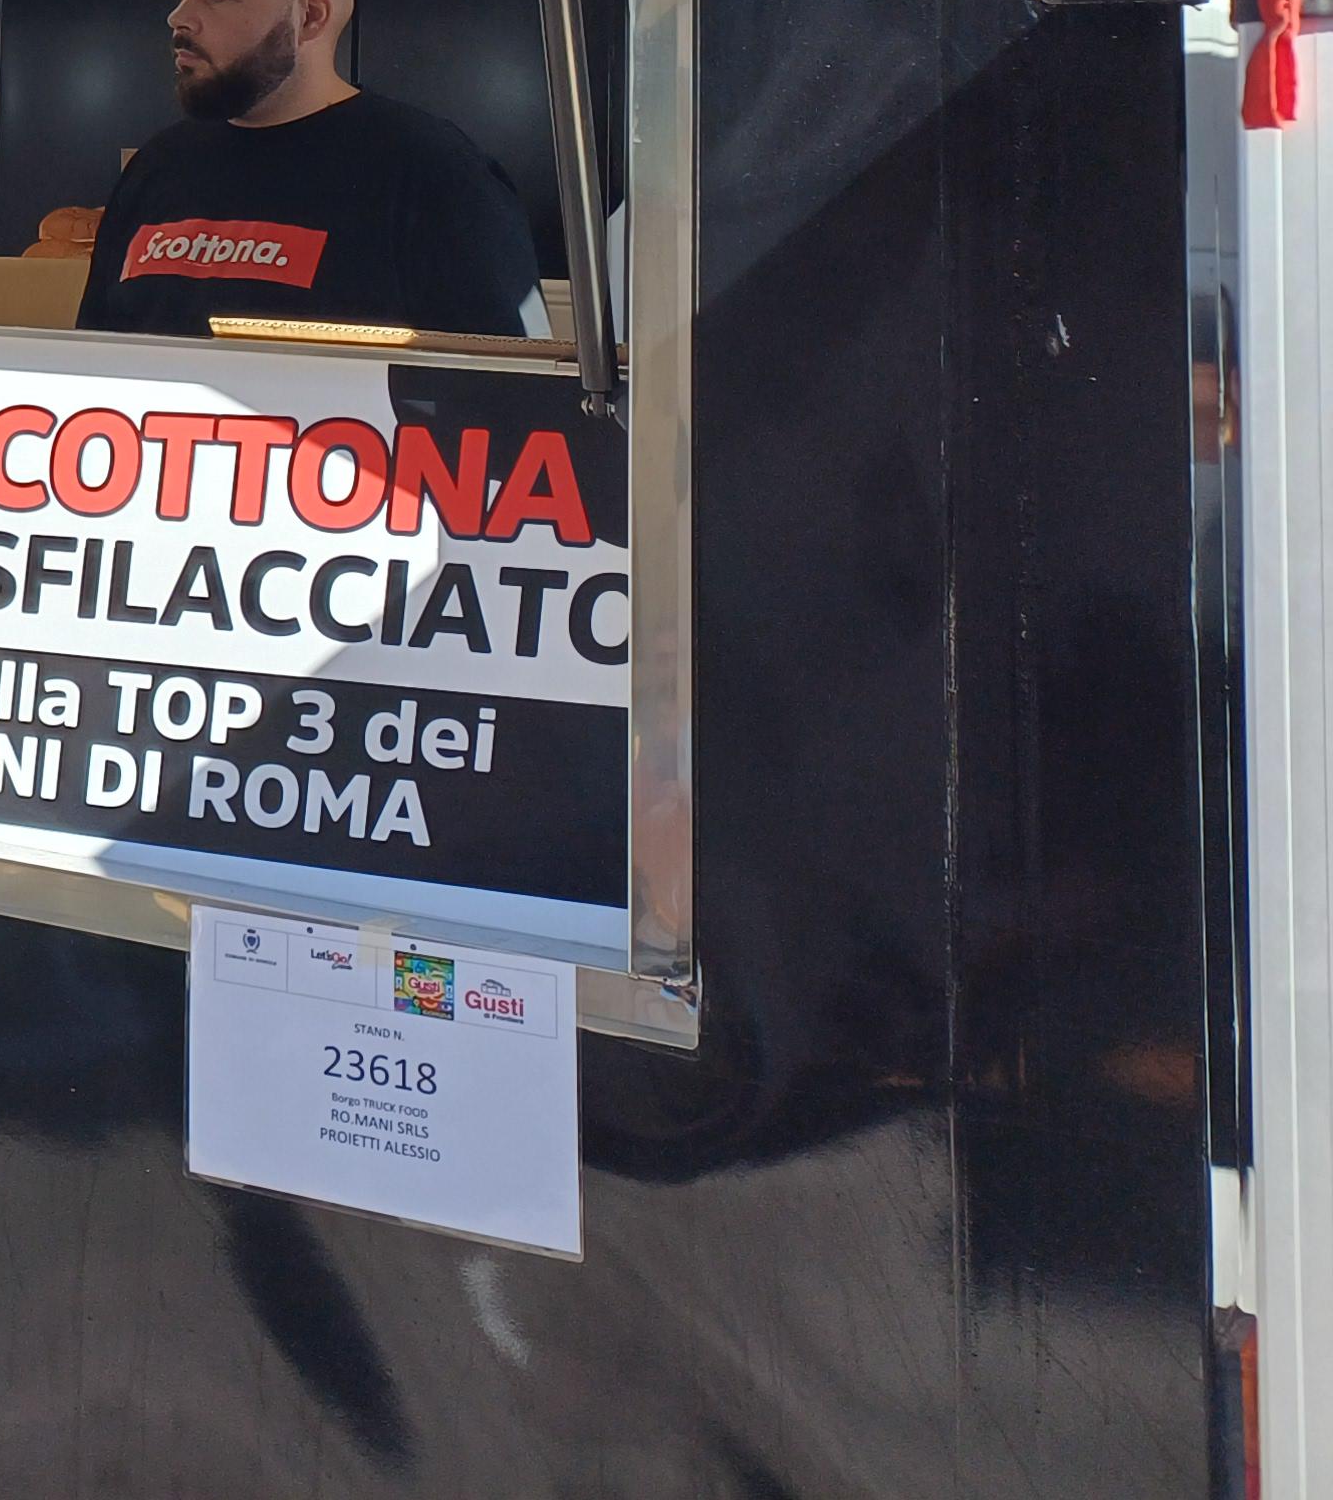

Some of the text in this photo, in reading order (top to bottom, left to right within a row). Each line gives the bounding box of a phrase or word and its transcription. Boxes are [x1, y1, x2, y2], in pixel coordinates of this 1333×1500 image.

[109, 670, 262, 745] TOP
[287, 691, 335, 754] 3
[363, 700, 497, 773] dei
[85, 743, 161, 814] DI
[189, 755, 431, 848] ROMA
[464, 990, 524, 1017] Gusti
[354, 1023, 405, 1041] STAND N.
[324, 1046, 437, 1095] 23618
[332, 1092, 428, 1119] Borgo TRUCK FOOD
[331, 1108, 429, 1139] RO.MANI SRLS
[320, 1127, 441, 1162] PROIETTI ALESSIO
